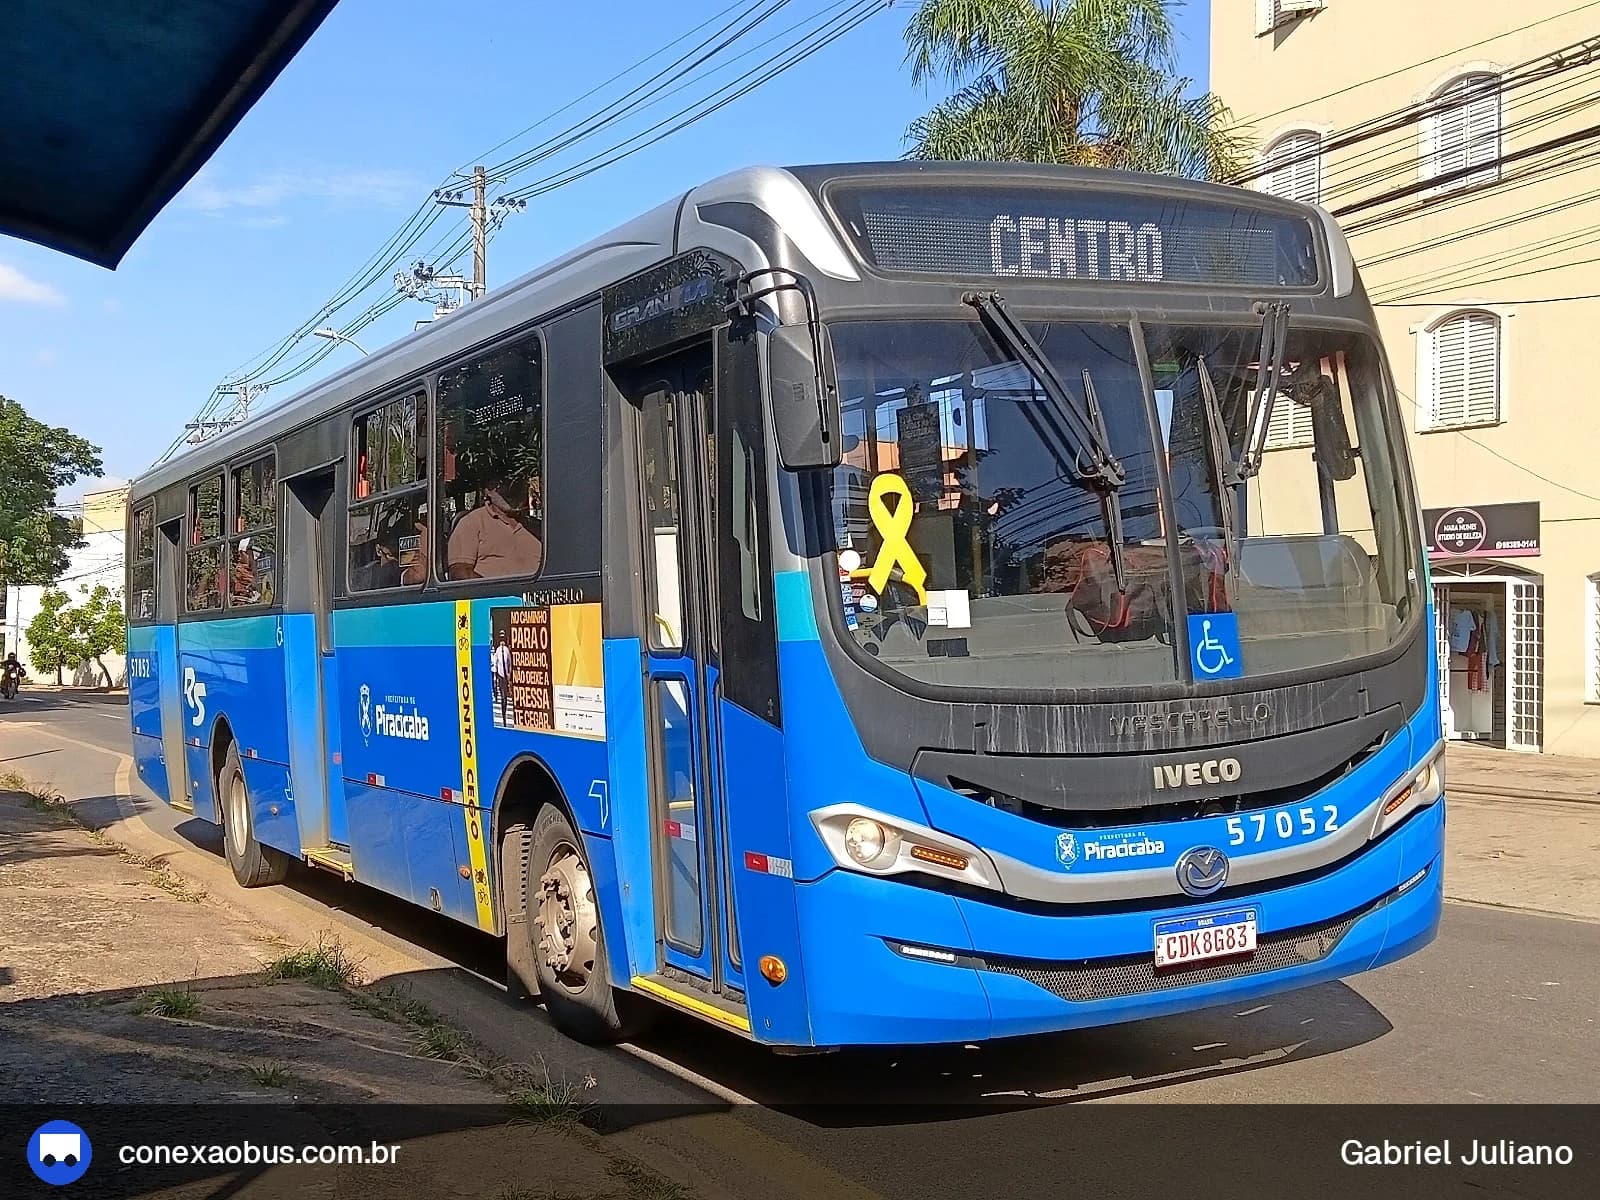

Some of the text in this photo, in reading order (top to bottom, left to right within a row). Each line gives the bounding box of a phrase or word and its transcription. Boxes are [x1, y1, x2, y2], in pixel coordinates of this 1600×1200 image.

[990, 214, 1164, 283] CENTRO
[510, 610, 547, 624] NO CAMINHO
[511, 627, 548, 649] PARA O
[512, 651, 548, 670] TRABALHO,
[512, 667, 550, 686] NÃO DEIXE A
[513, 686, 550, 710] PRESSA
[375, 704, 430, 741] Piracicaba
[515, 709, 524, 727] TE
[1109, 702, 1271, 737] MASCARELLO
[461, 666, 480, 841] PONTO CEGO
[1153, 757, 1242, 790] IVECO
[1226, 804, 1338, 846] 57052
[1084, 837, 1165, 861] Piracicaba
[1166, 924, 1248, 960] CDK8G83
